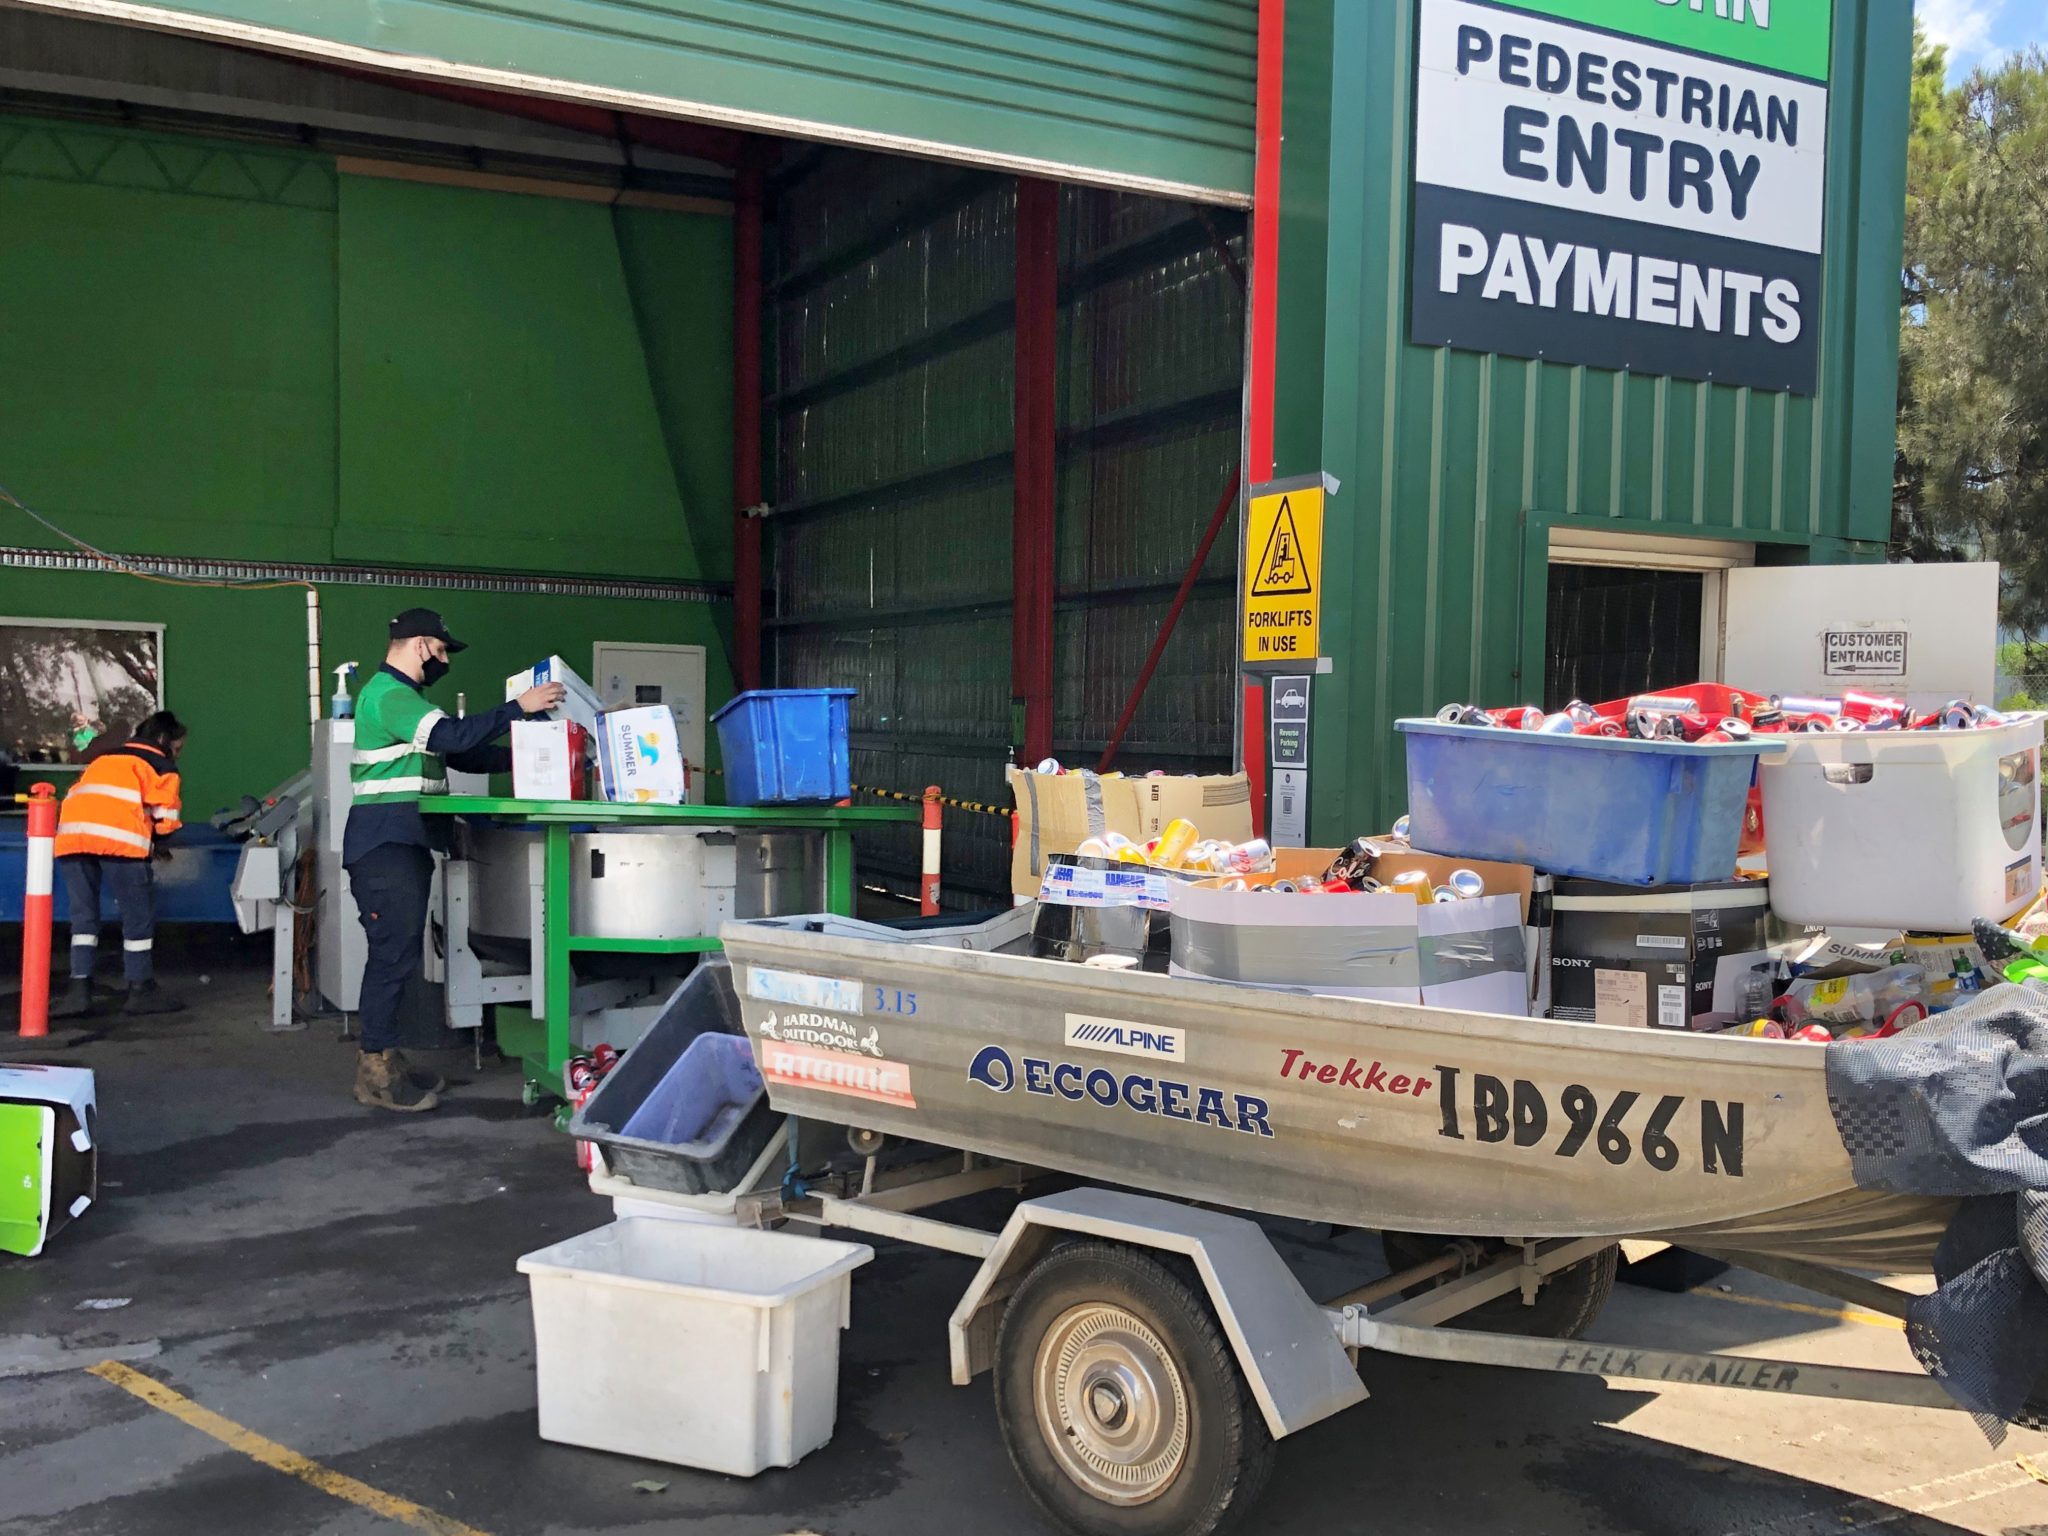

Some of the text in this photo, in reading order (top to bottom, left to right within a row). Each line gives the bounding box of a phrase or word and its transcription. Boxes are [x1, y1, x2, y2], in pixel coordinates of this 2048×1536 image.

[1456, 24, 1799, 147] PEDESTRIAN
[1502, 104, 1761, 221] ENTRY
[1438, 222, 1802, 344] PAYMENTS
[1249, 610, 1312, 627] FORKLIFTS
[1258, 635, 1297, 652] IN USE
[1829, 634, 1902, 646] CUSTOMER
[1829, 650, 1902, 663] ENTRANCE
[1279, 728, 1299, 737] Reverse
[1280, 738, 1299, 748] Parking
[621, 724, 637, 777] SUMMER
[1281, 748, 1296, 757] ONLY
[1552, 957, 1592, 968] SONY
[1695, 981, 1713, 992] SONY
[874, 987, 918, 1015] 3.15
[783, 1013, 857, 1037] HARDMAN
[782, 1028, 859, 1050] OUTDOORS
[1103, 1027, 1175, 1053] ALPINE
[1280, 1048, 1433, 1098] Trekker
[1020, 1056, 1276, 1139] ECOGEAR
